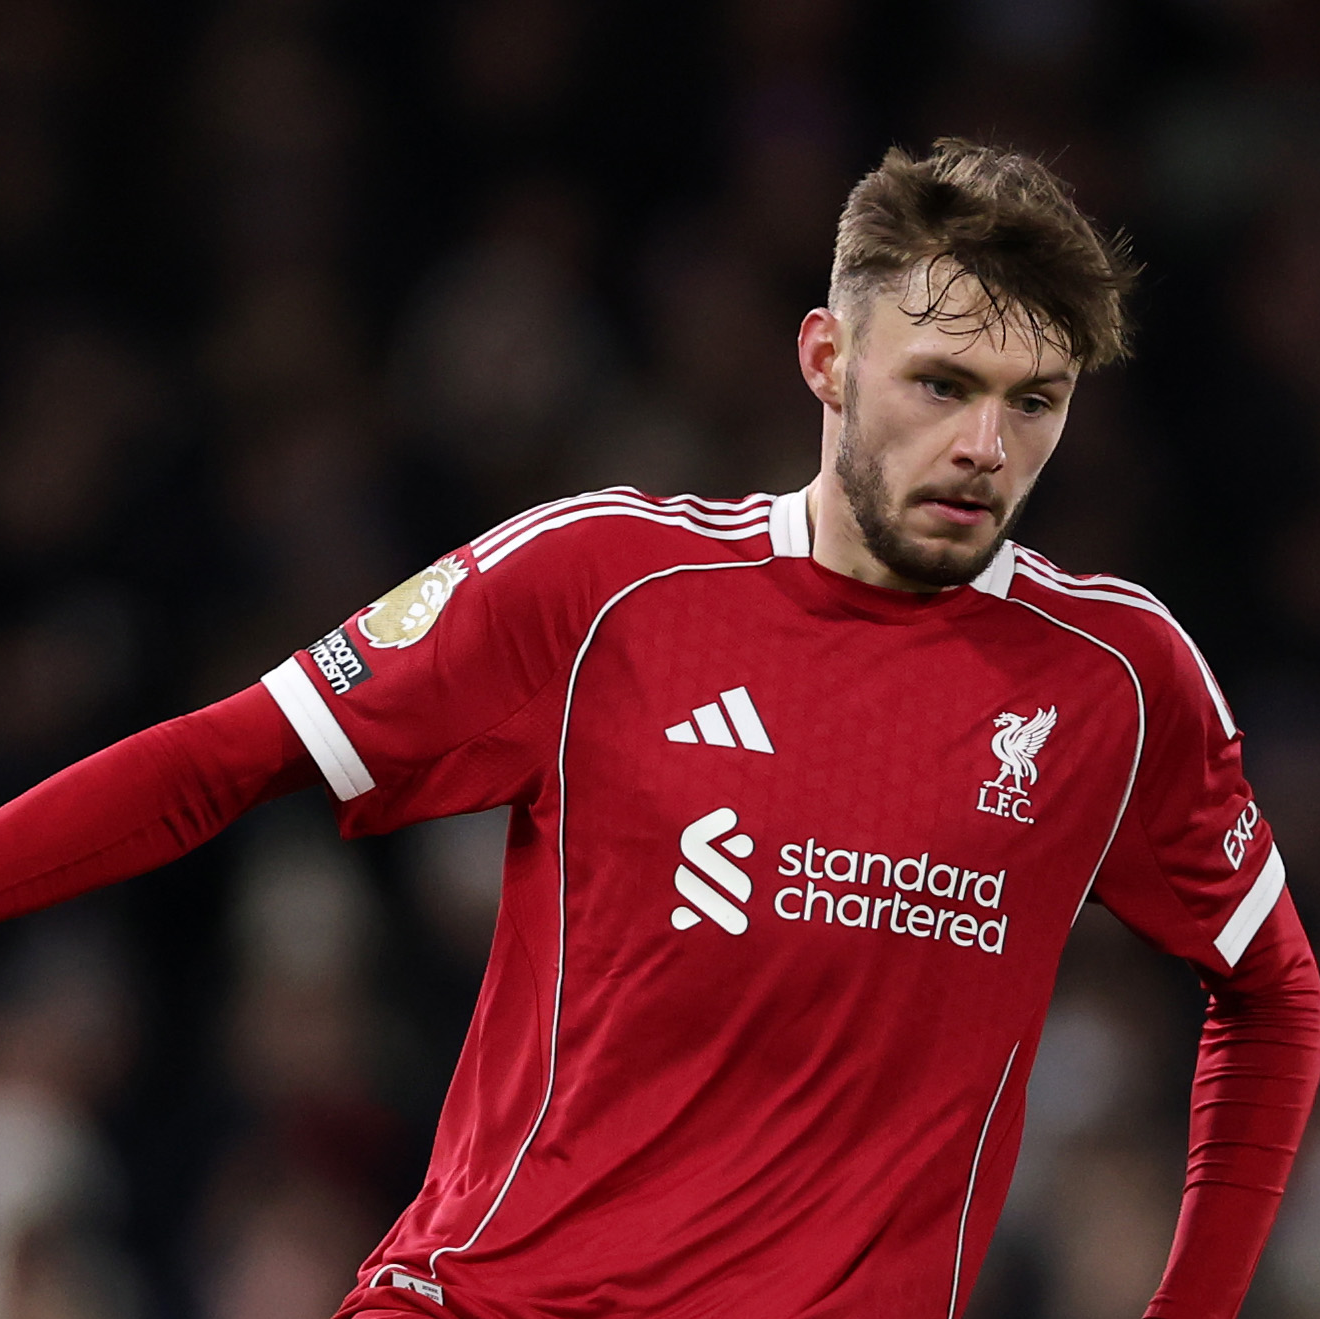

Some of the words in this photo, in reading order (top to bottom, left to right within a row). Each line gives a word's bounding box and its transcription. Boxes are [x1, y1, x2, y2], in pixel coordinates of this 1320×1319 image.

[308, 643, 351, 695] racism
[976, 787, 1035, 824] L.F.C.
[778, 838, 1006, 909] standard
[774, 880, 1008, 955] chartered
